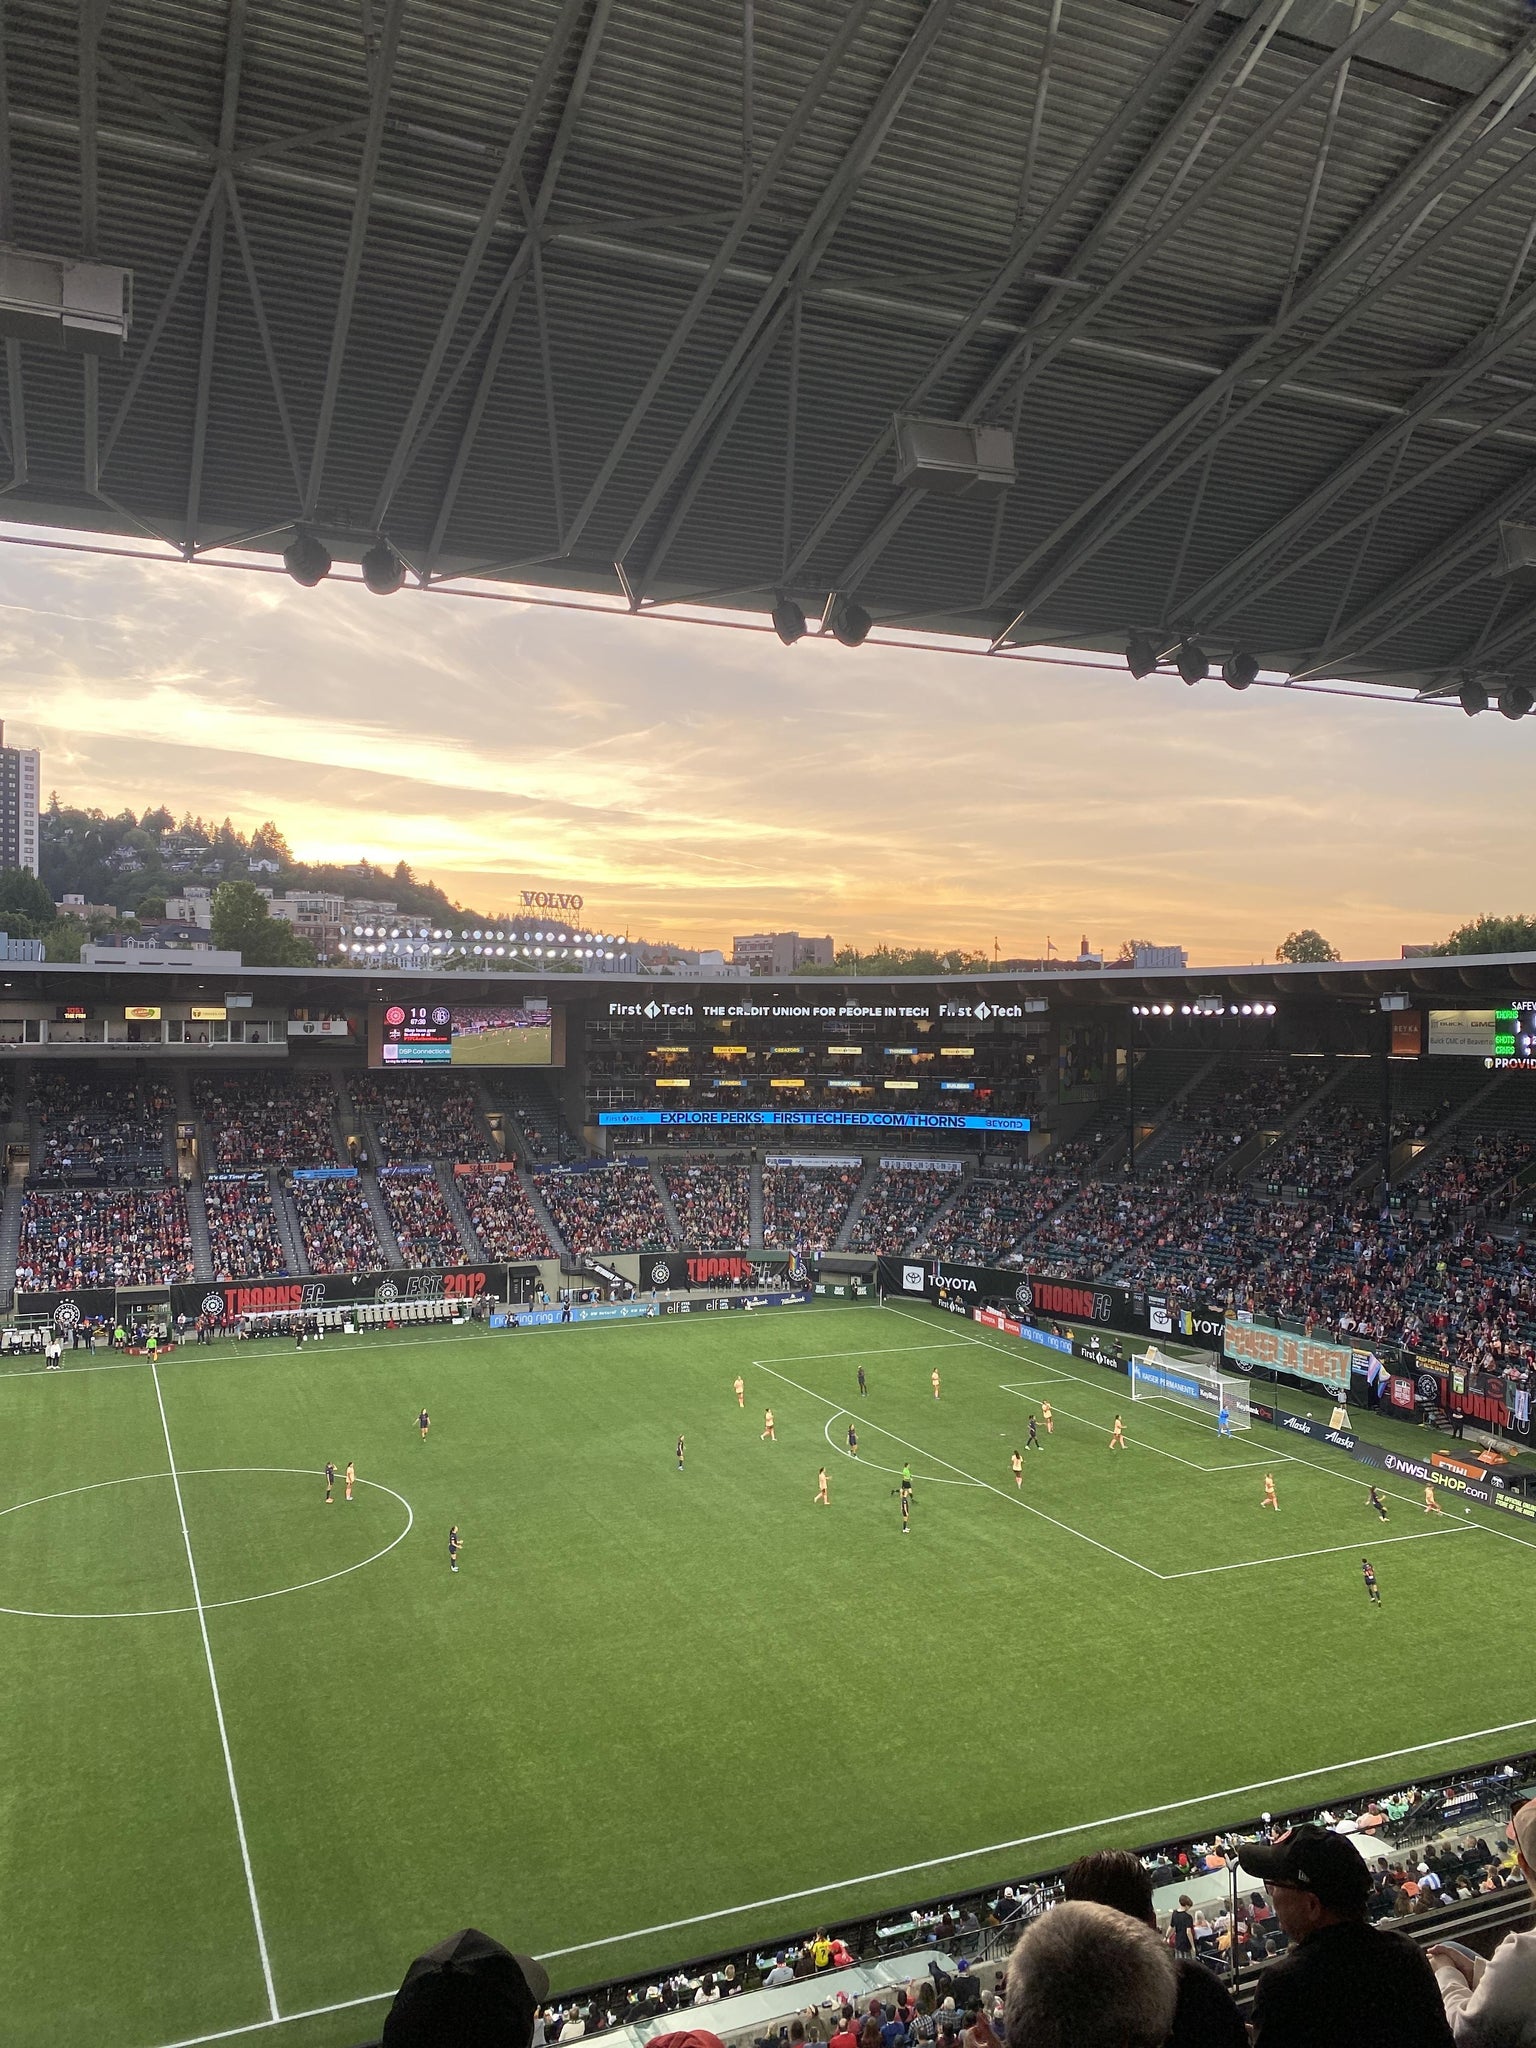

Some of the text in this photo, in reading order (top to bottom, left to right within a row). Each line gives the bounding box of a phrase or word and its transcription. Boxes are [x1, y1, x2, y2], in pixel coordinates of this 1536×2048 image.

[520, 890, 584, 910] VOLVO
[410, 1007, 427, 1018] 1 0
[609, 1003, 694, 1017] First Tech
[702, 1006, 930, 1018] THE CRDIT UNION FOR PEOPLE IN TECH
[990, 1003, 1023, 1018] Tech
[1495, 1010, 1519, 1020] THORNS
[1393, 1024, 1419, 1033] REYKA
[1470, 1021, 1496, 1029] GMC
[1430, 1036, 1445, 1045] Buick
[1445, 1037, 1460, 1045] GMC
[1495, 1035, 1516, 1045] SHOTS
[660, 1112, 967, 1129] EXPLORE PERKS: FIRSTTECHFED.COM/THORNS
[687, 1257, 750, 1283] THORNS
[444, 1272, 486, 1300] 2012
[927, 1274, 978, 1292] TOYOTA
[225, 1284, 303, 1314] THORNS
[667, 1301, 681, 1314] elf
[706, 1298, 720, 1311] elf
[938, 1298, 966, 1315] First Tech
[1032, 1282, 1095, 1318] THORNS
[1091, 1292, 1113, 1322] FC
[536, 1312, 554, 1323] ring
[1225, 1323, 1279, 1364] POWER
[1081, 1347, 1118, 1369] First Tech
[1142, 1372, 1195, 1396] KAISER PERMANENTE
[1200, 1388, 1221, 1401] KeyBan
[1283, 1416, 1311, 1434] Alaska
[1324, 1430, 1355, 1449] Alaska
[1395, 1461, 1489, 1502] NWSLSHOP.com
